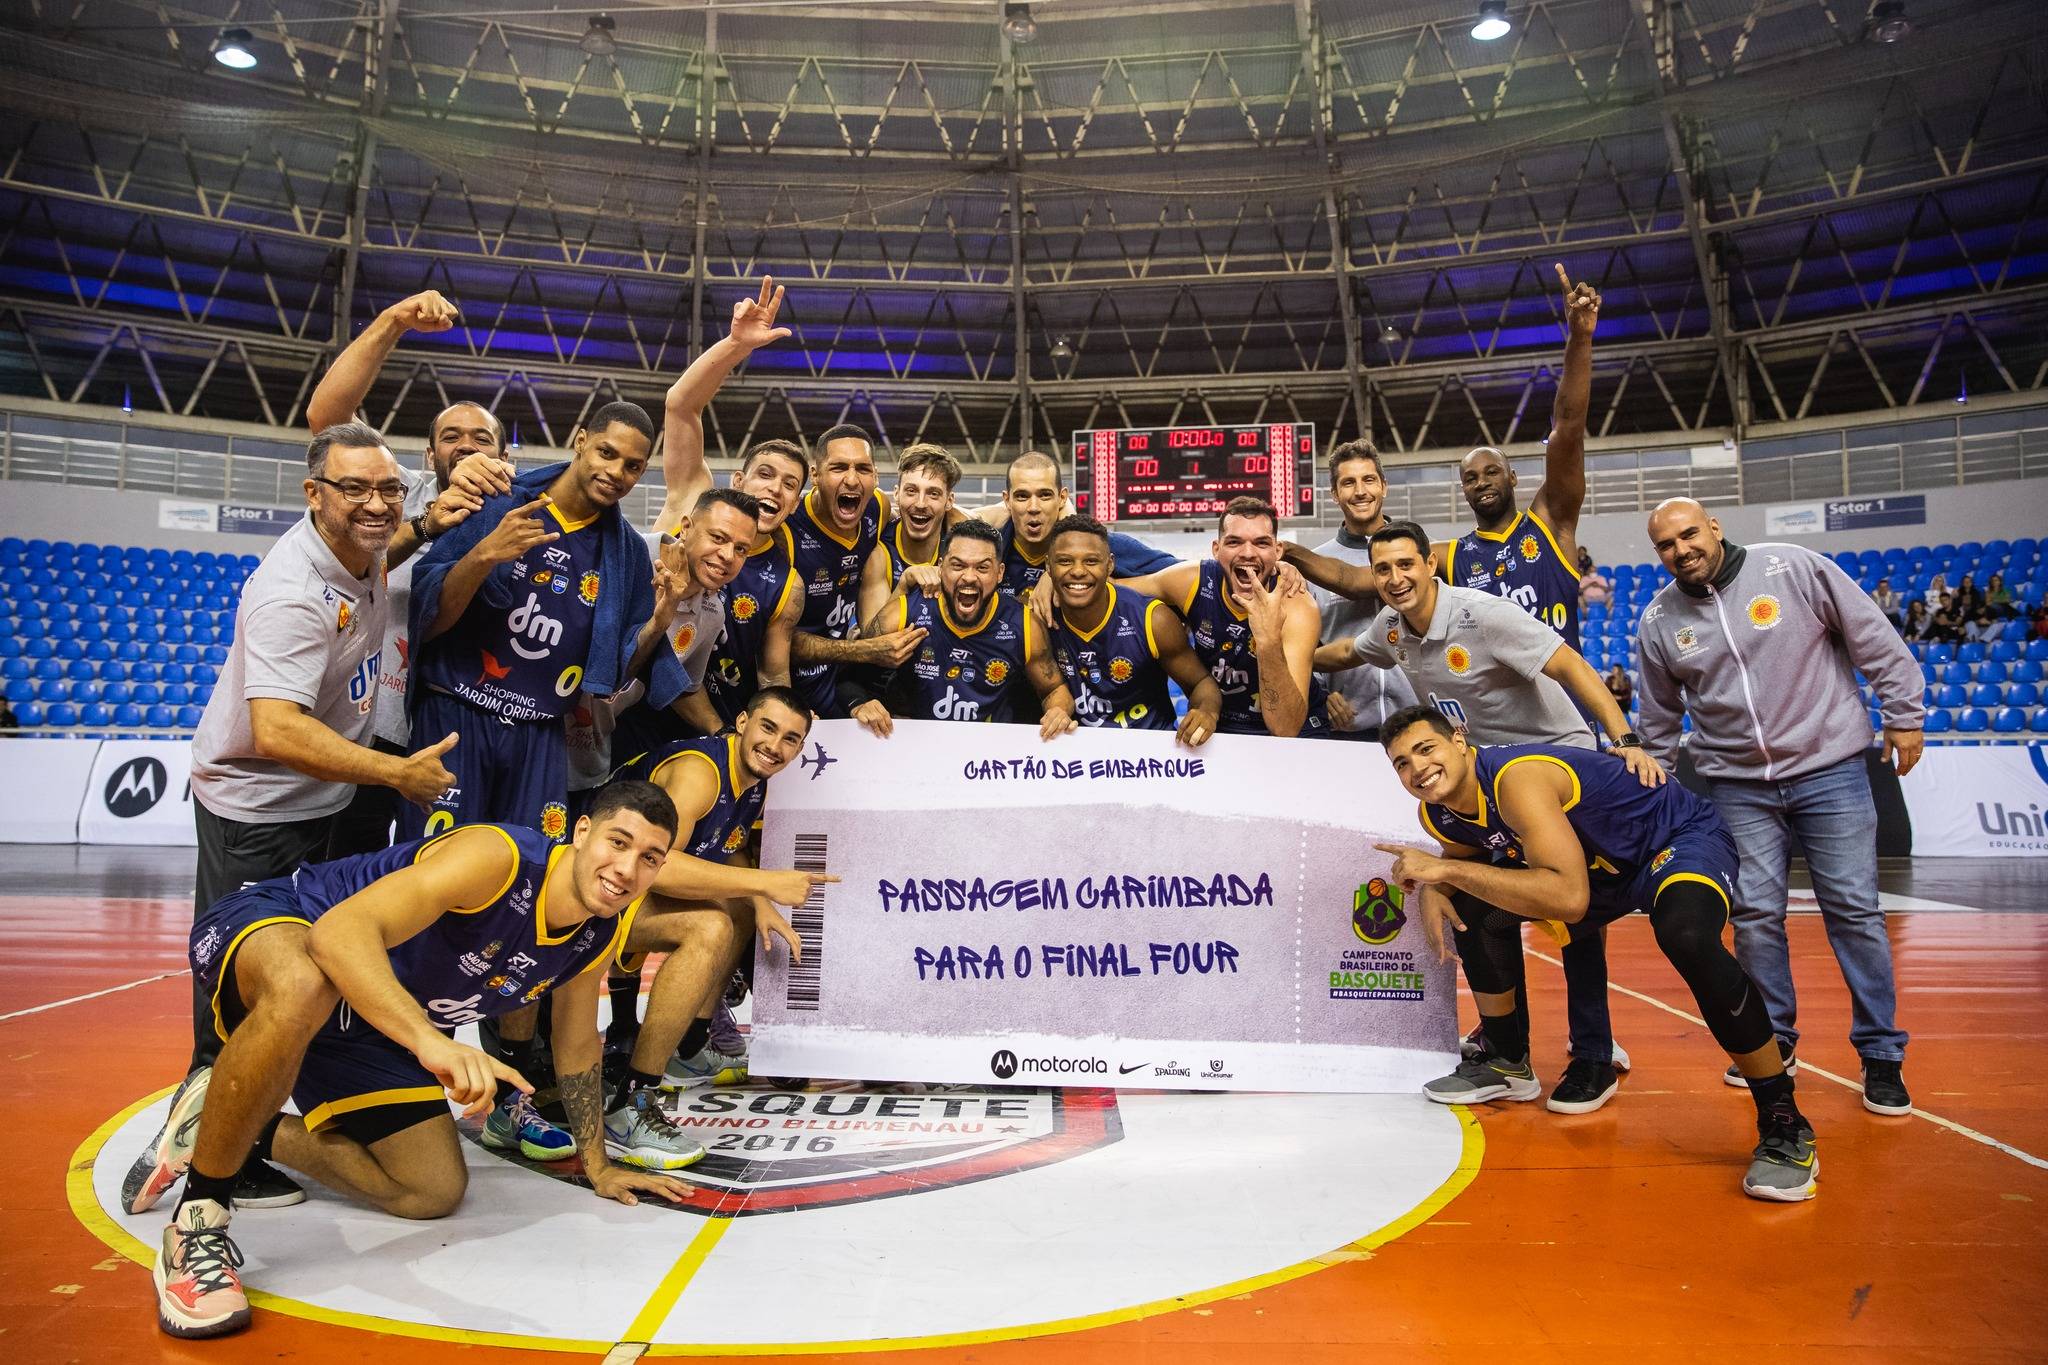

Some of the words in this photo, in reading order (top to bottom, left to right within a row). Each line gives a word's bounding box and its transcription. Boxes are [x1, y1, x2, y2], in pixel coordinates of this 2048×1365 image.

[222, 506, 262, 519] Setor
[266, 510, 274, 520] 1
[1829, 501, 1872, 515] Setor
[1879, 500, 1885, 510] 1
[1541, 603, 1567, 630] 10
[926, 664, 940, 672] JOSÉ
[555, 665, 583, 697] 0
[455, 683, 500, 712] JARDIM
[483, 683, 536, 707] SHOPPING
[964, 755, 1047, 780] CARTÃO
[1052, 760, 1084, 779] DE
[1089, 758, 1205, 779] EMBARQUE
[1976, 802, 2048, 837] Uni
[878, 877, 1067, 912] PASSAGEM
[914, 944, 1004, 981] PARA
[1014, 945, 1032, 979] O
[1149, 940, 1239, 974] FOUR
[1340, 961, 1399, 971] BRASILEIRO
[1401, 963, 1415, 971] DE
[1342, 950, 1413, 961] CAMPEONATO
[1329, 971, 1425, 990] BASQUETE
[1332, 989, 1421, 999] #BASQUETEPARATODOS
[1021, 1055, 1108, 1073] motorola
[1155, 1067, 1191, 1077] SPALDING
[1200, 1071, 1233, 1079] UniCesumar
[784, 1119, 983, 1134] BLUMENAU
[710, 1133, 836, 1152] 2016
